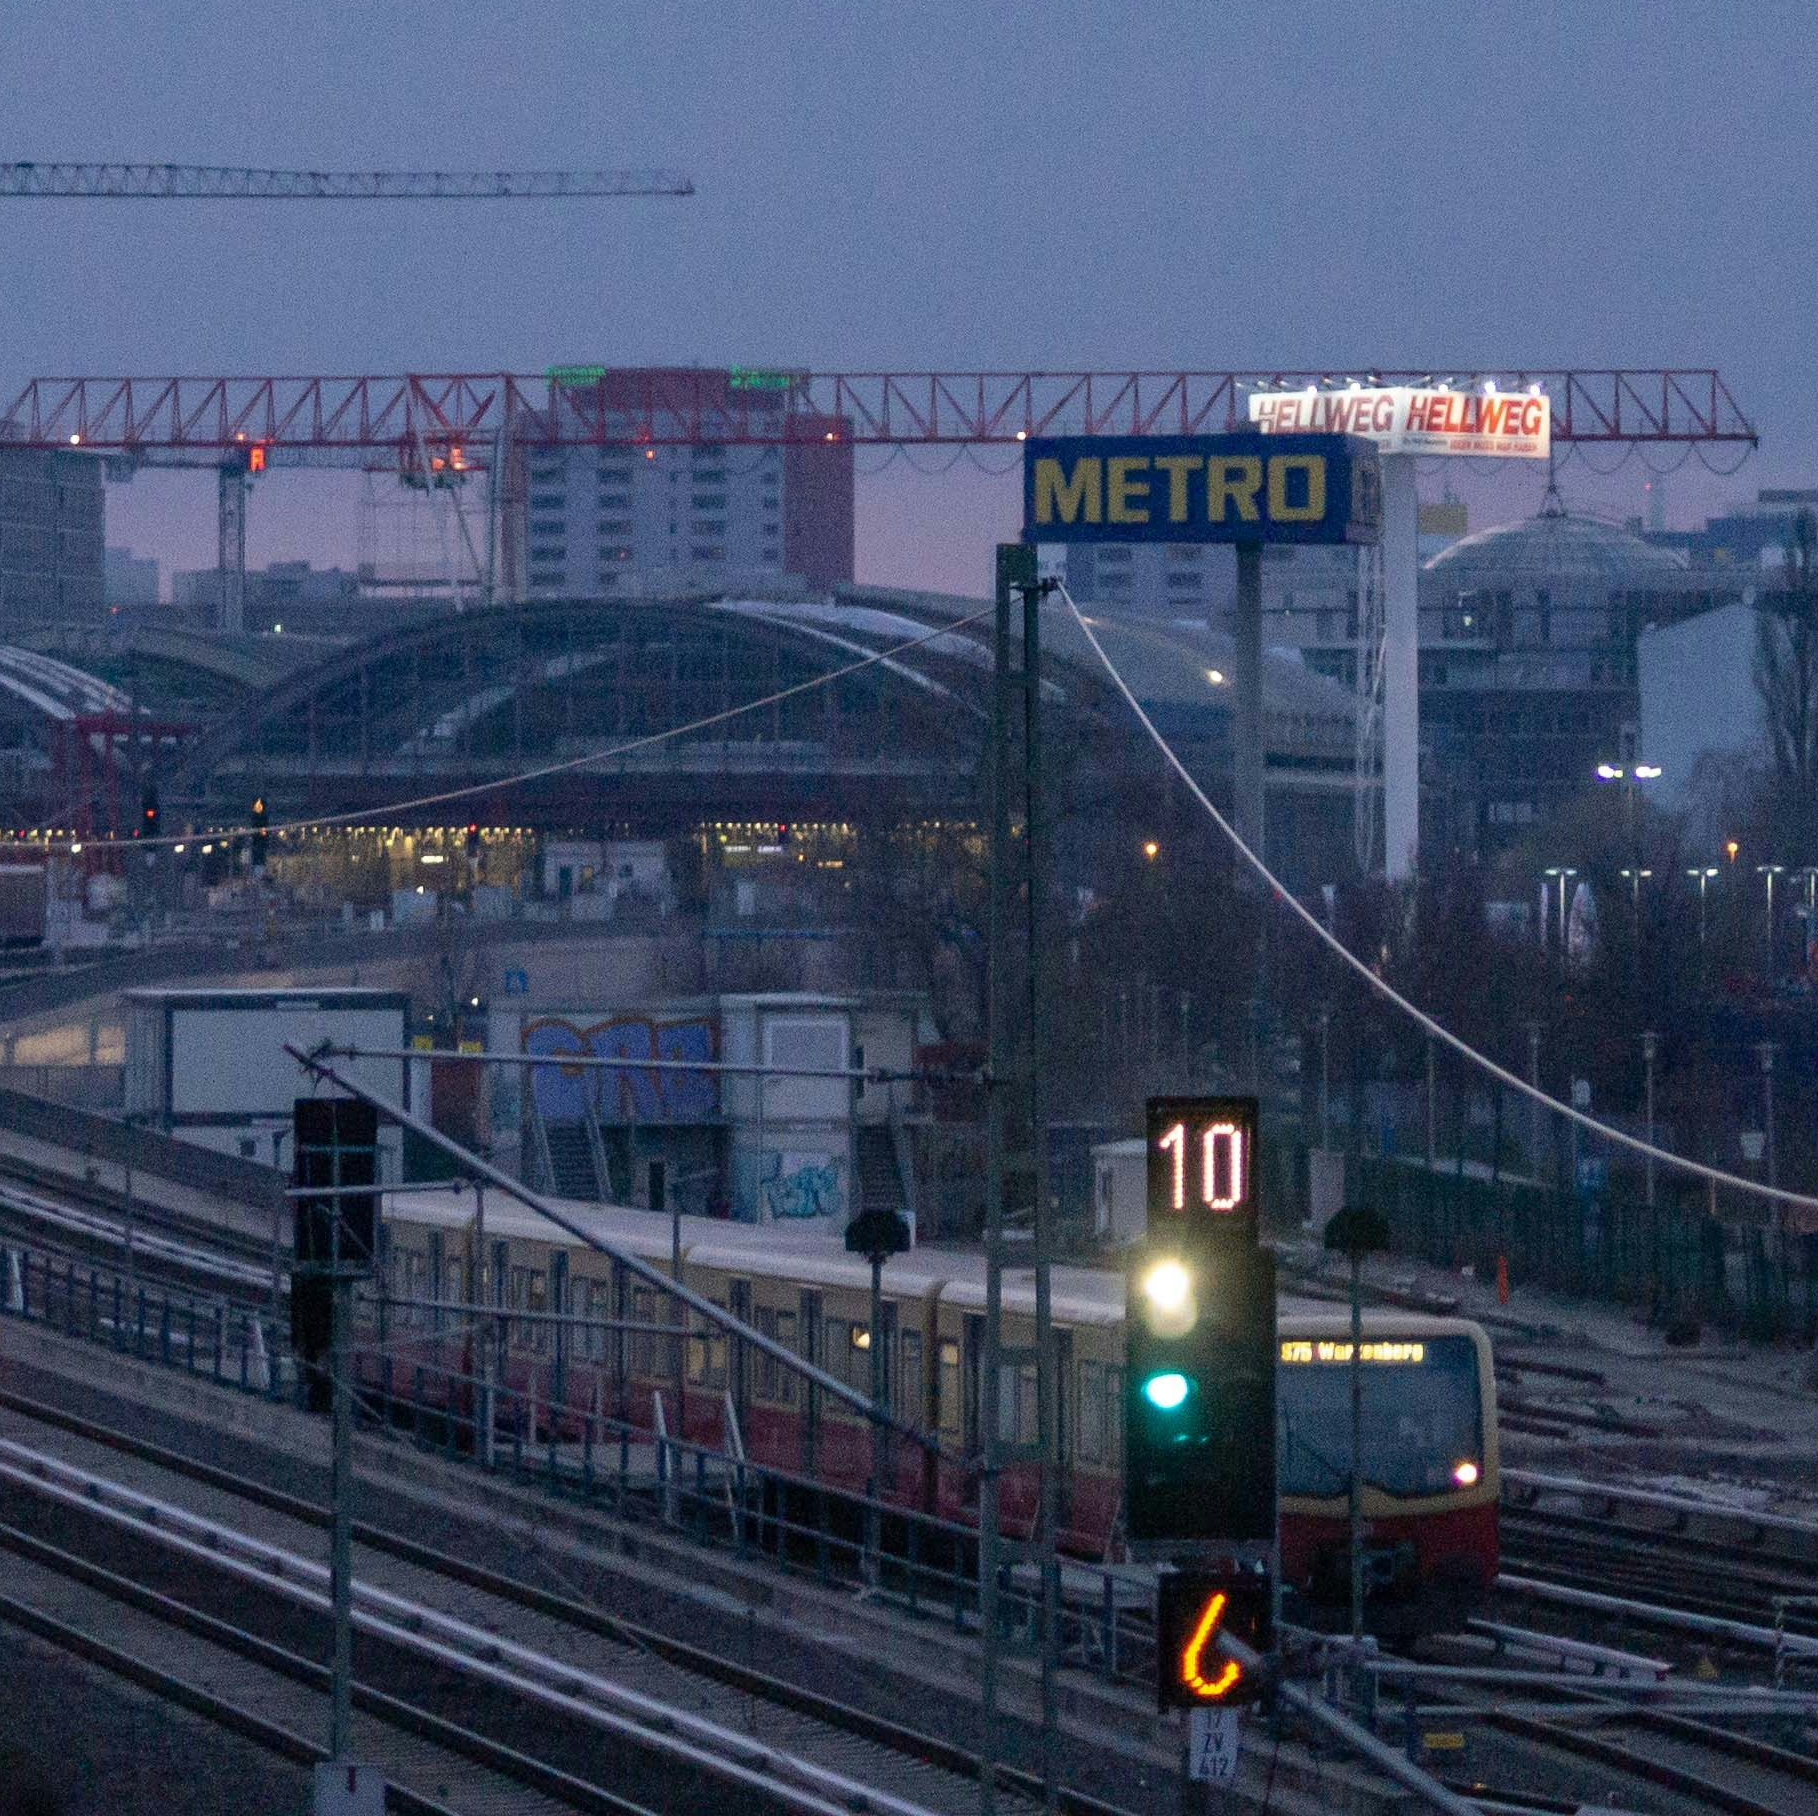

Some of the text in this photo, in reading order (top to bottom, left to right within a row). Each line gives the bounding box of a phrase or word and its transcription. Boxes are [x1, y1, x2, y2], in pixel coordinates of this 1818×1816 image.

[1258, 394, 1394, 434] HELLWEG
[1406, 394, 1542, 435] HELLWEG
[1035, 455, 1325, 524] METRO
[1159, 1123, 1242, 1210] 10
[1281, 1341, 1425, 1362] S75 Warenberg
[1183, 1593, 1241, 1696] 6
